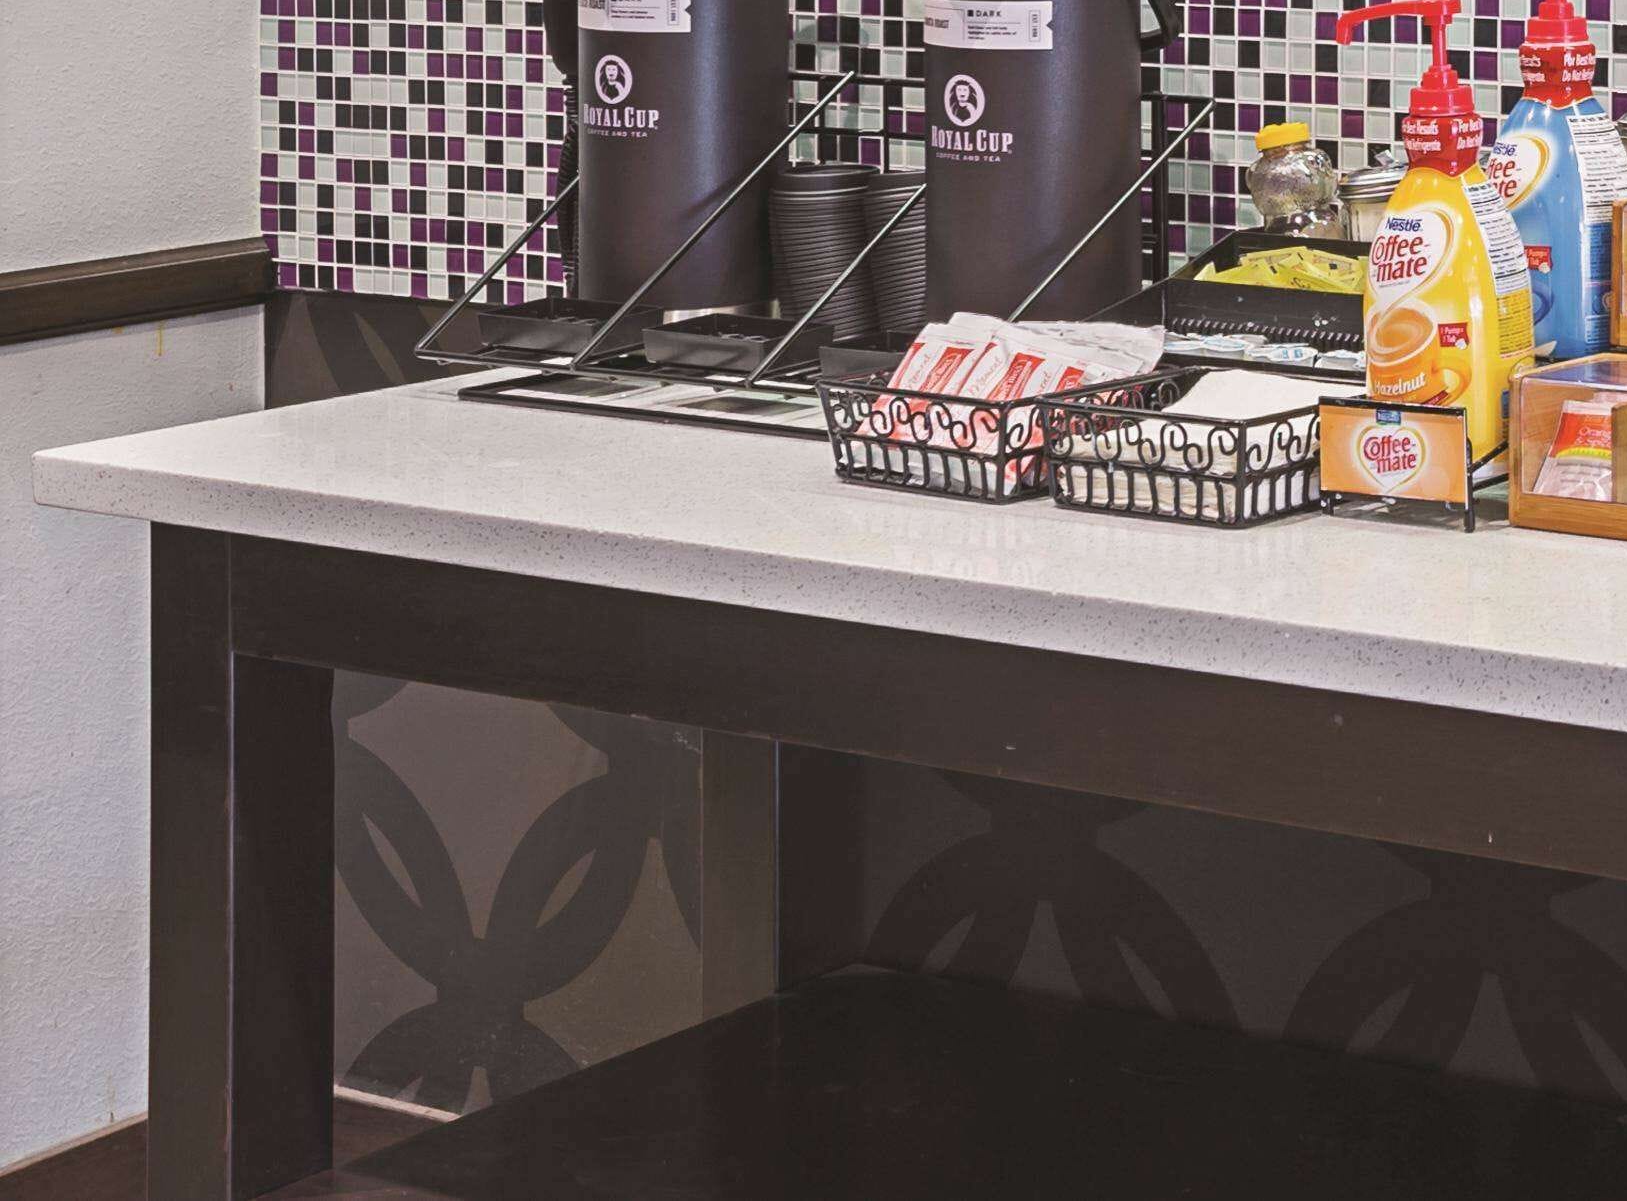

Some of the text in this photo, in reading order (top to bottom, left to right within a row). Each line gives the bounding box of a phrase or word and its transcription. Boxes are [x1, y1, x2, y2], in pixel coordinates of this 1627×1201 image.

[583, 103, 660, 129] ROYAL CUP
[931, 125, 1013, 152] ROYAL CUP
[1385, 217, 1422, 232] Nestlé
[1376, 257, 1427, 282] mate
[1374, 371, 1427, 395] Hazelnut
[1376, 454, 1417, 474] mate
